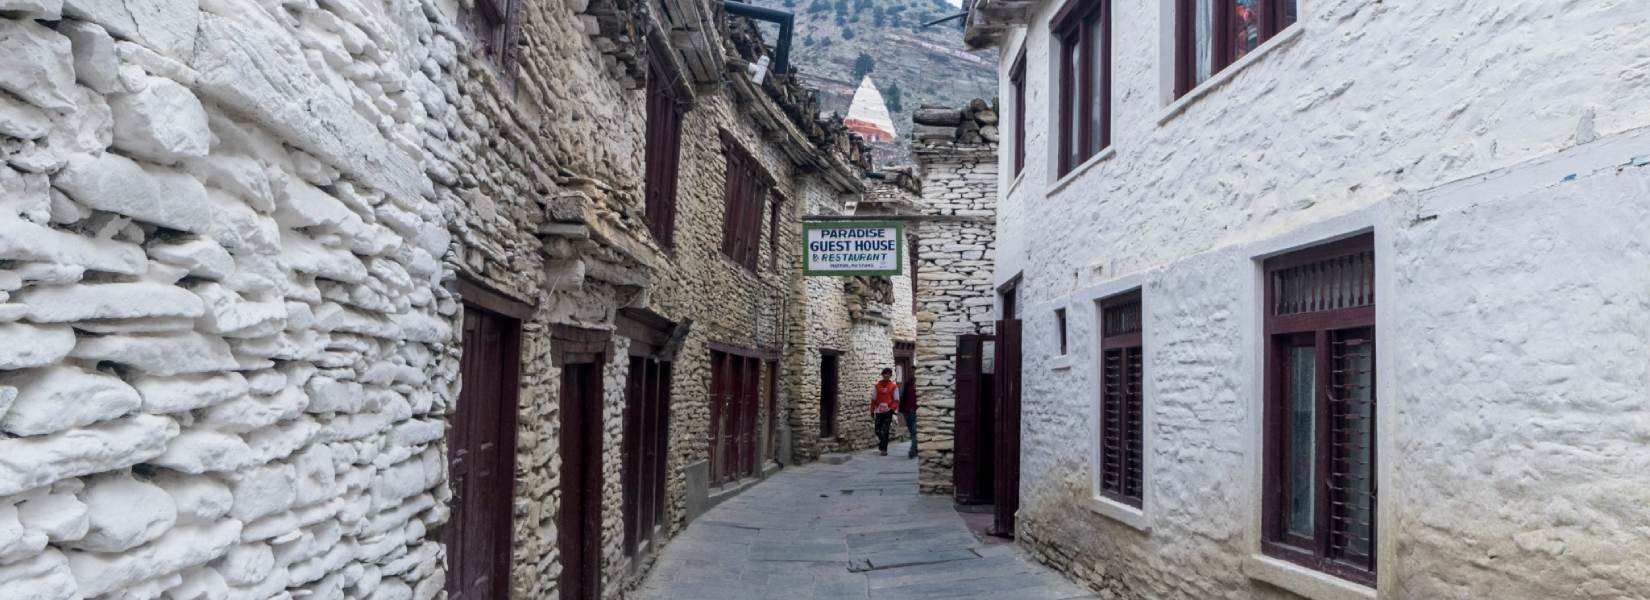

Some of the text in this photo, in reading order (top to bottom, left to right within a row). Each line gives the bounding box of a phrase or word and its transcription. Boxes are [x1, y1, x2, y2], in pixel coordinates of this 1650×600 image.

[821, 228, 885, 238] PARADISE
[810, 240, 895, 252] GUEST HOUSE
[821, 253, 887, 262] RESTAURANT
